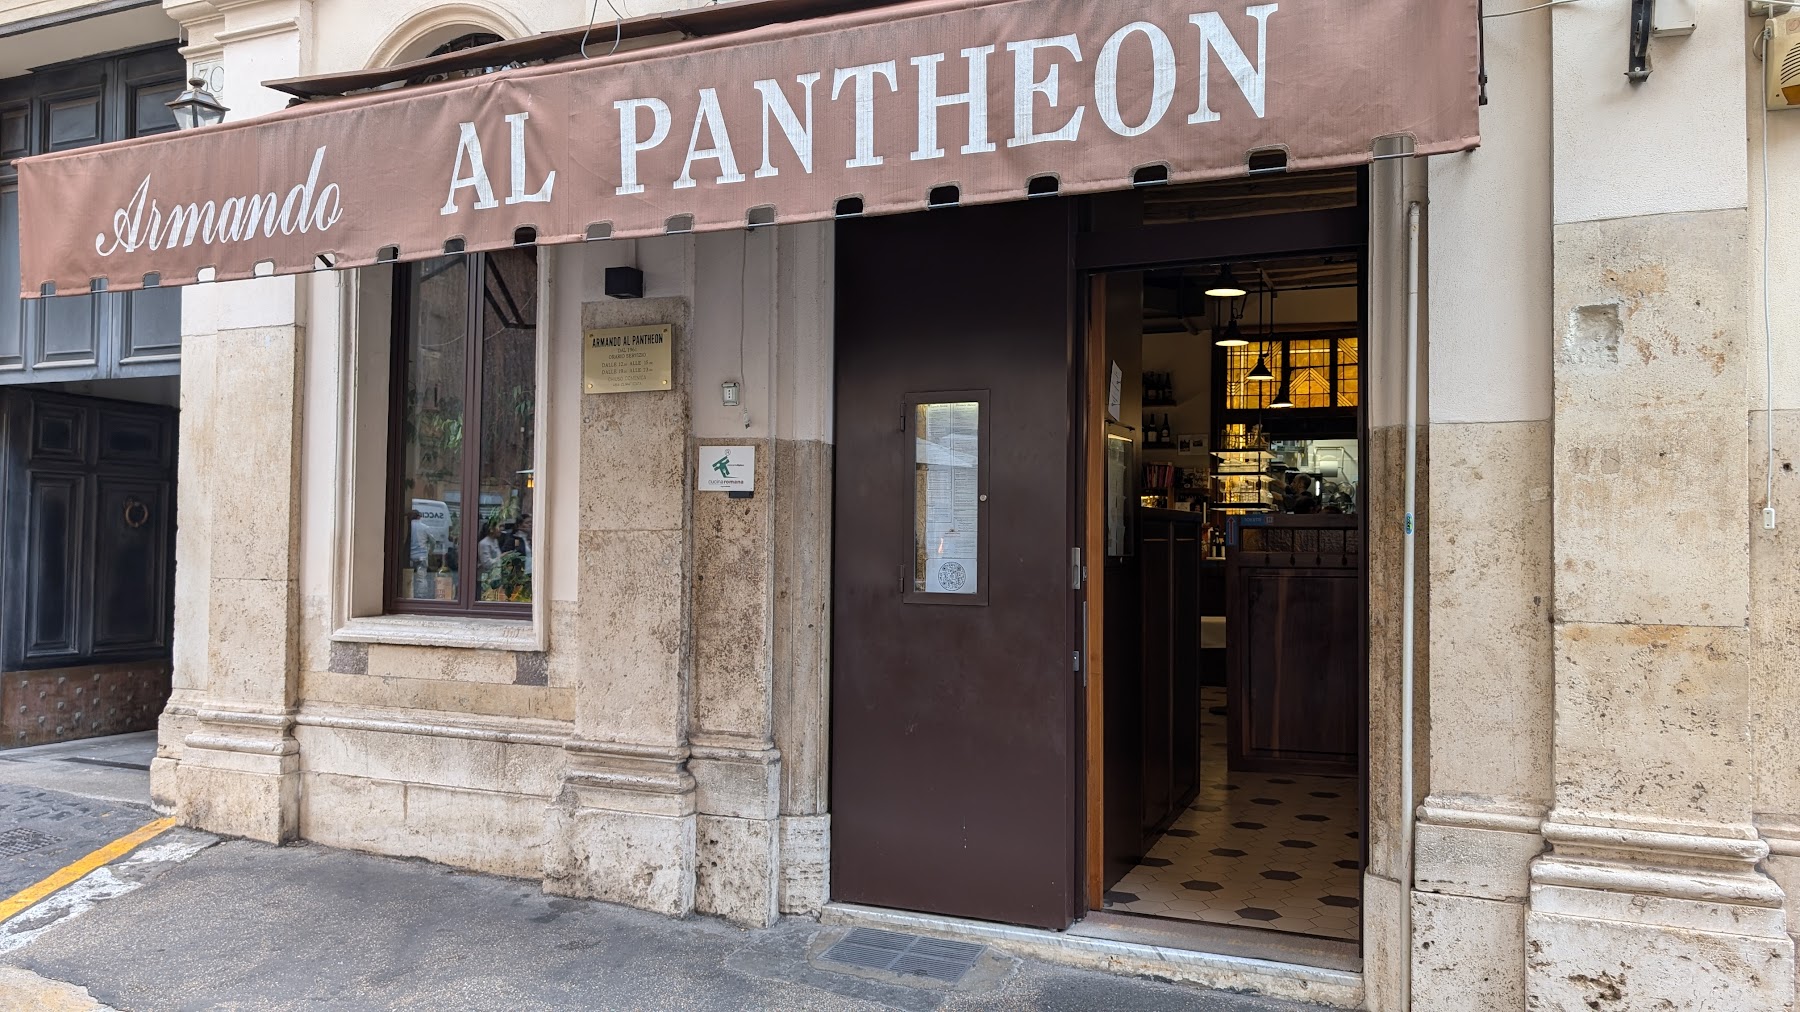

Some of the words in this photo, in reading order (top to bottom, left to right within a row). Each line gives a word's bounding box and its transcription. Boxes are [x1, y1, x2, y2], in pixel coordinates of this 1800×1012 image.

[95, 145, 344, 257] Armando
[440, 112, 556, 215] AL
[613, 3, 1279, 195] PANTHEON
[592, 337, 621, 347] ARMANDO
[623, 336, 630, 346] AL
[633, 334, 663, 345] PANTHEON
